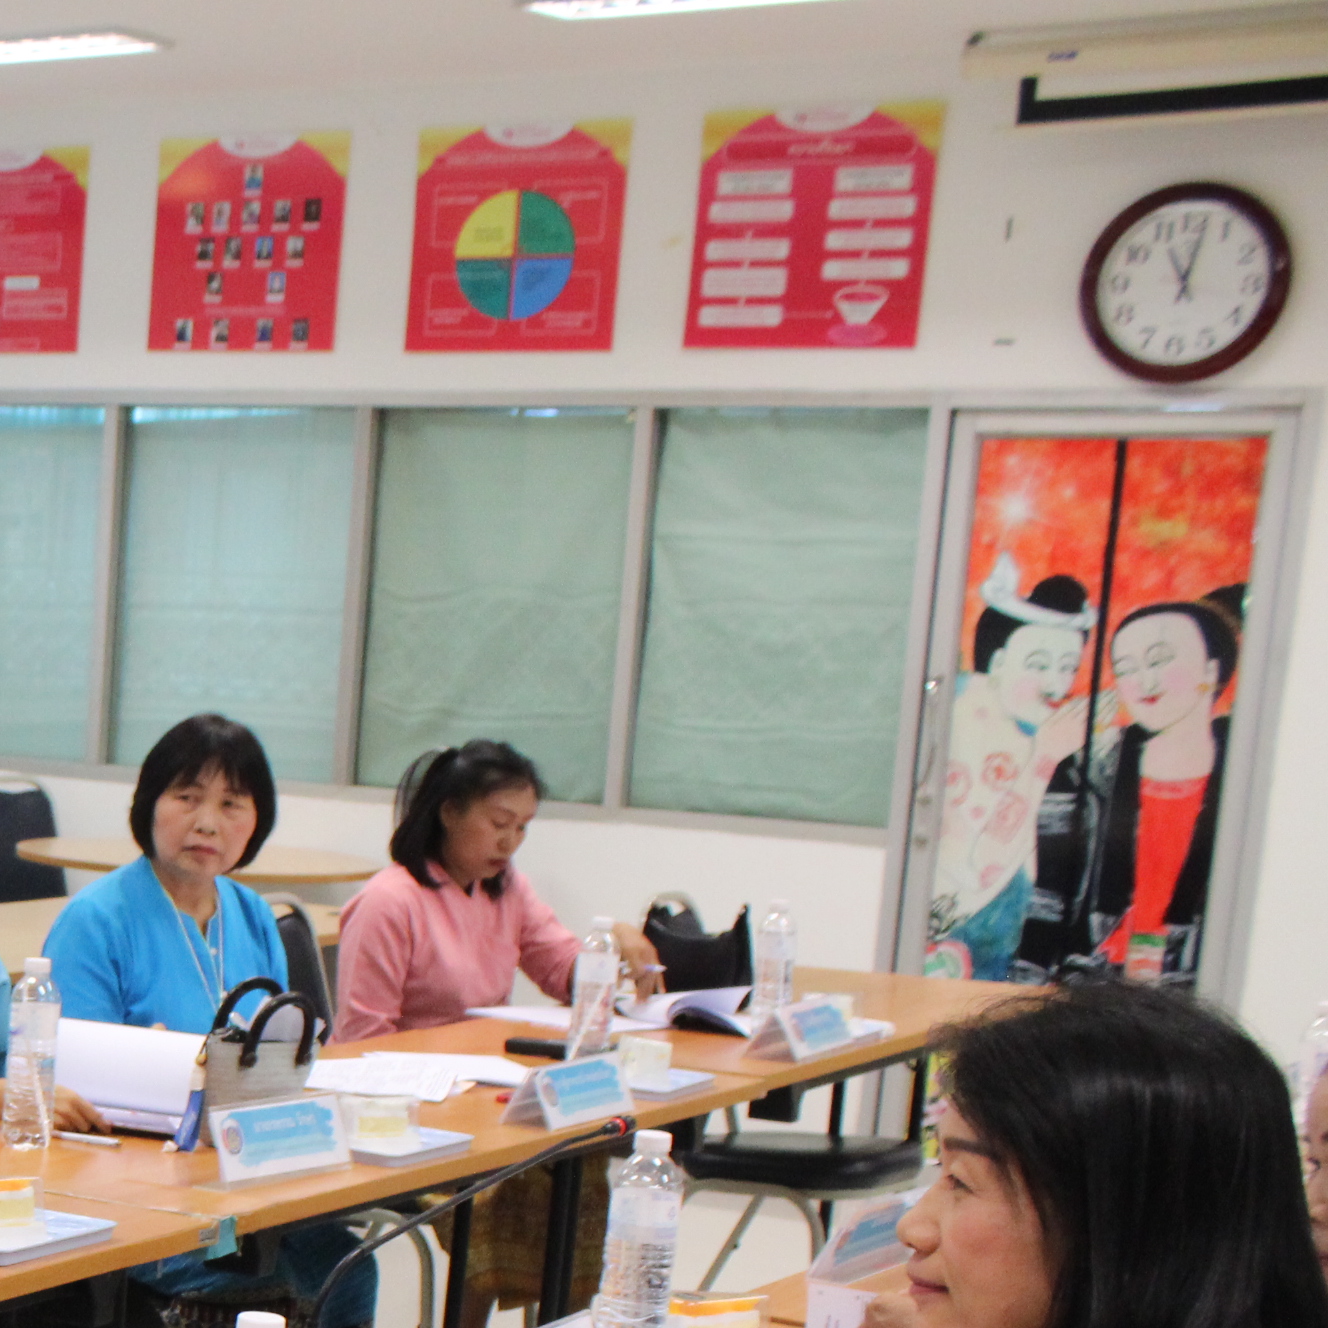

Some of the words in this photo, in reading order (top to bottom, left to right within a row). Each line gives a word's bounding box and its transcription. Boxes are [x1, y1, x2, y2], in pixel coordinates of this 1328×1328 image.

[1154, 220, 1176, 243] 11
[1139, 327, 1157, 350] 7
[1164, 334, 1185, 357] 6
